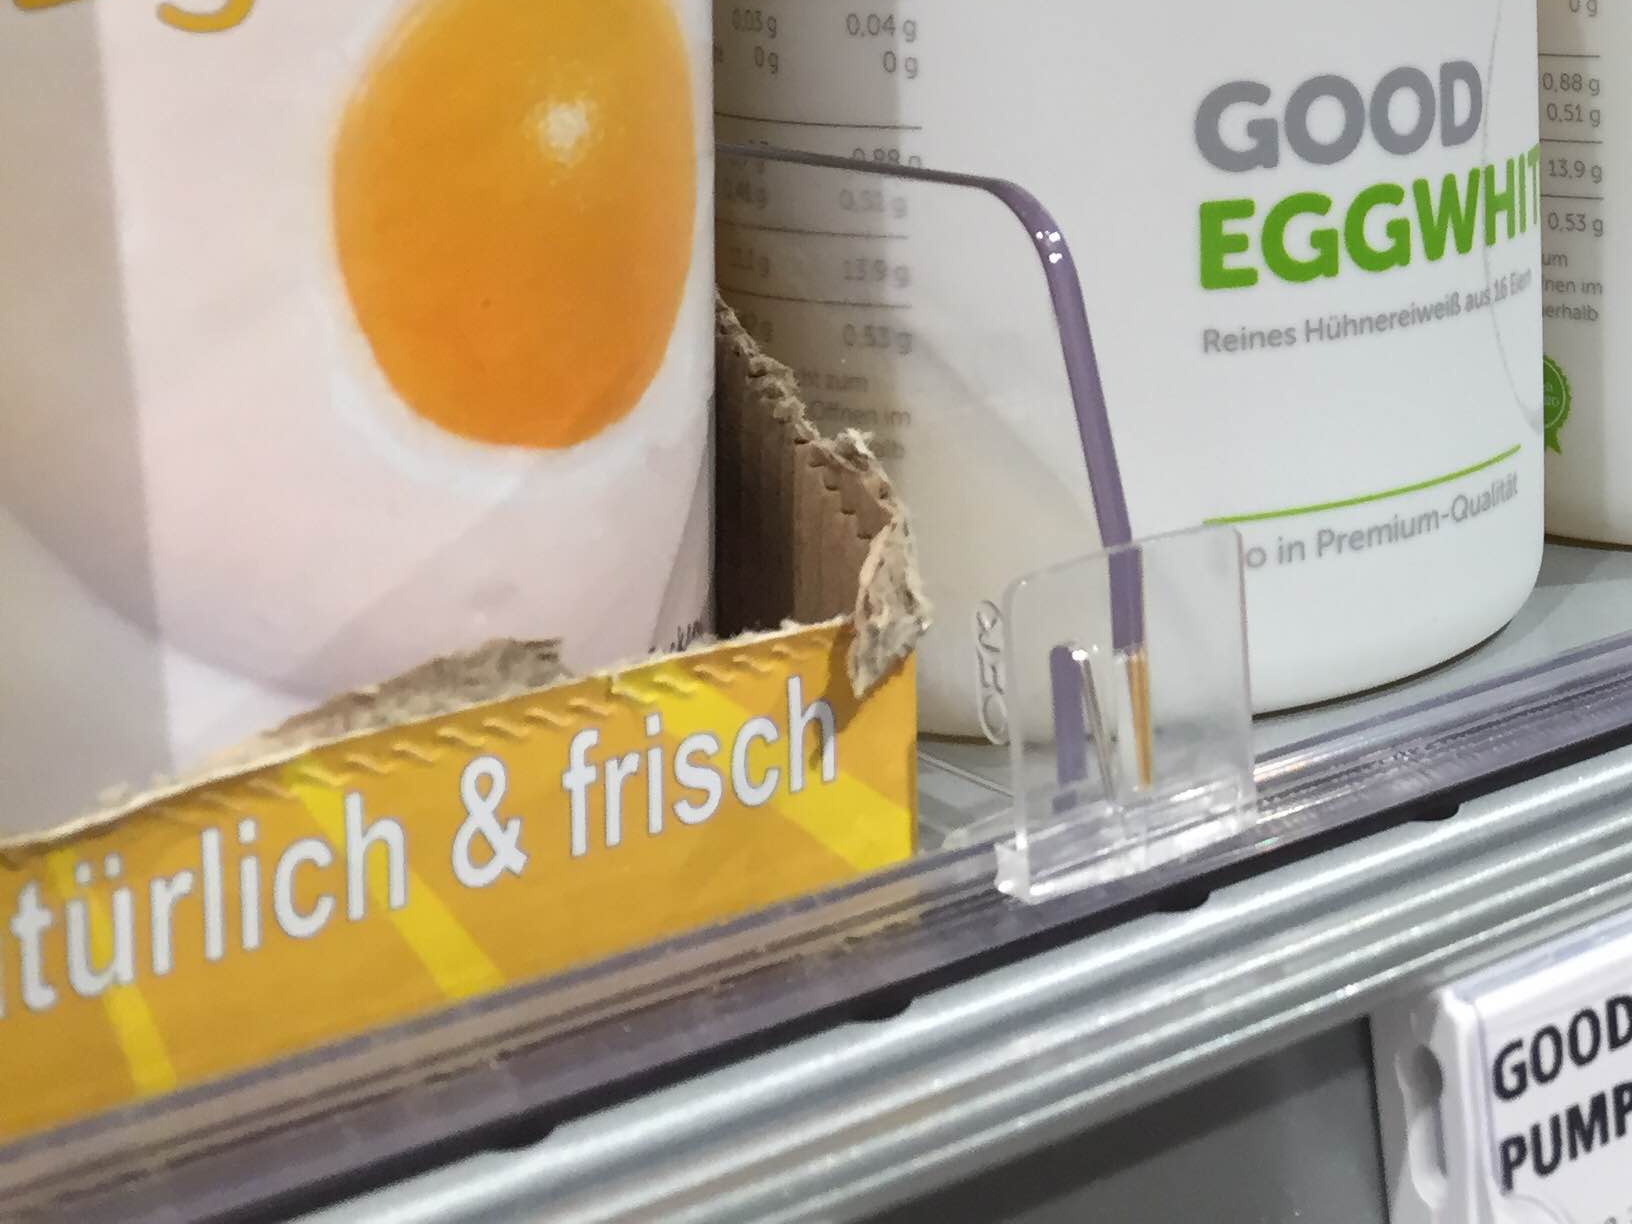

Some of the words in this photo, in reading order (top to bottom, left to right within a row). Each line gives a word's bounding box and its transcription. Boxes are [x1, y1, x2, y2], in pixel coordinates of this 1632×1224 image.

[883, 50, 897, 74] 0
[904, 56, 918, 79] g
[903, 20, 917, 43] g
[1194, 60, 1483, 173] GOOD
[1202, 324, 1298, 355] Reines
[1304, 294, 1461, 345] Hühnereiweiß
[1278, 540, 1305, 565] in
[1315, 470, 1519, 560] Premium-Qualität
[0, 784, 409, 1021] türlich
[451, 753, 530, 891] &
[561, 674, 838, 860] frisch
